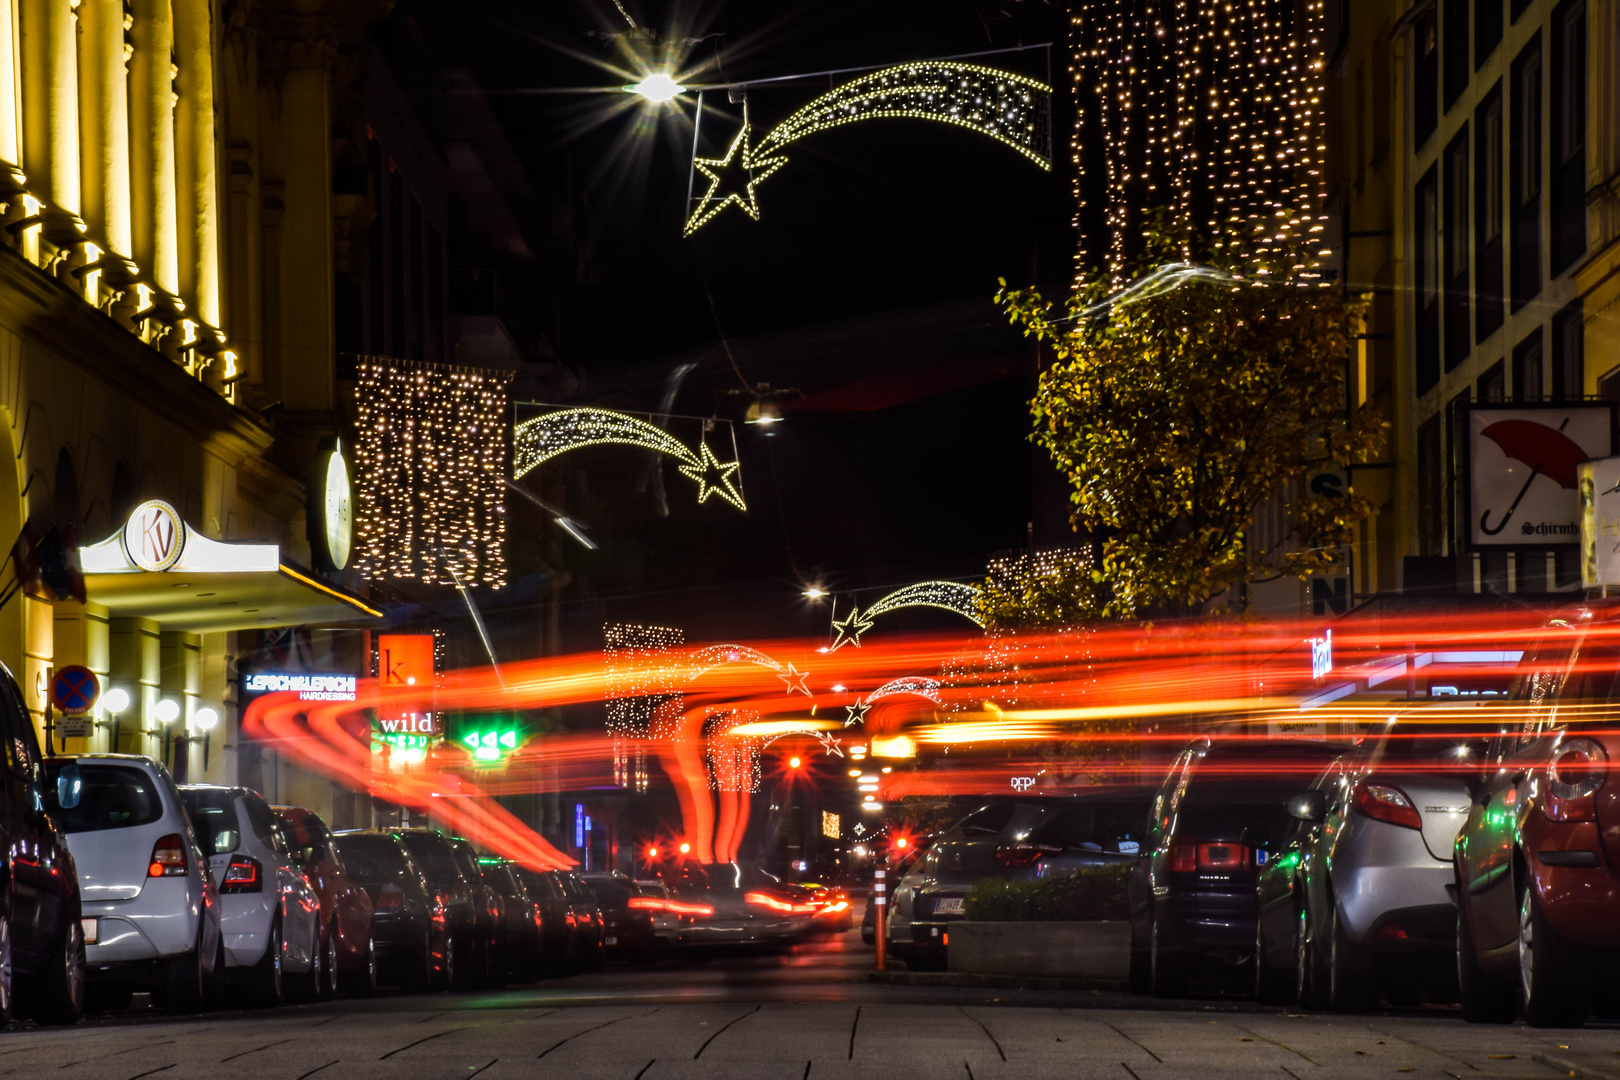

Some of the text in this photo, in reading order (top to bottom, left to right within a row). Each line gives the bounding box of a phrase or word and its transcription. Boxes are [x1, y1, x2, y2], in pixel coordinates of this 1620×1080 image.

[142, 509, 174, 562] KV
[1521, 521, 1580, 536] Schirmh
[299, 692, 356, 701] HAIRDRESSING
[381, 712, 433, 732] wild
